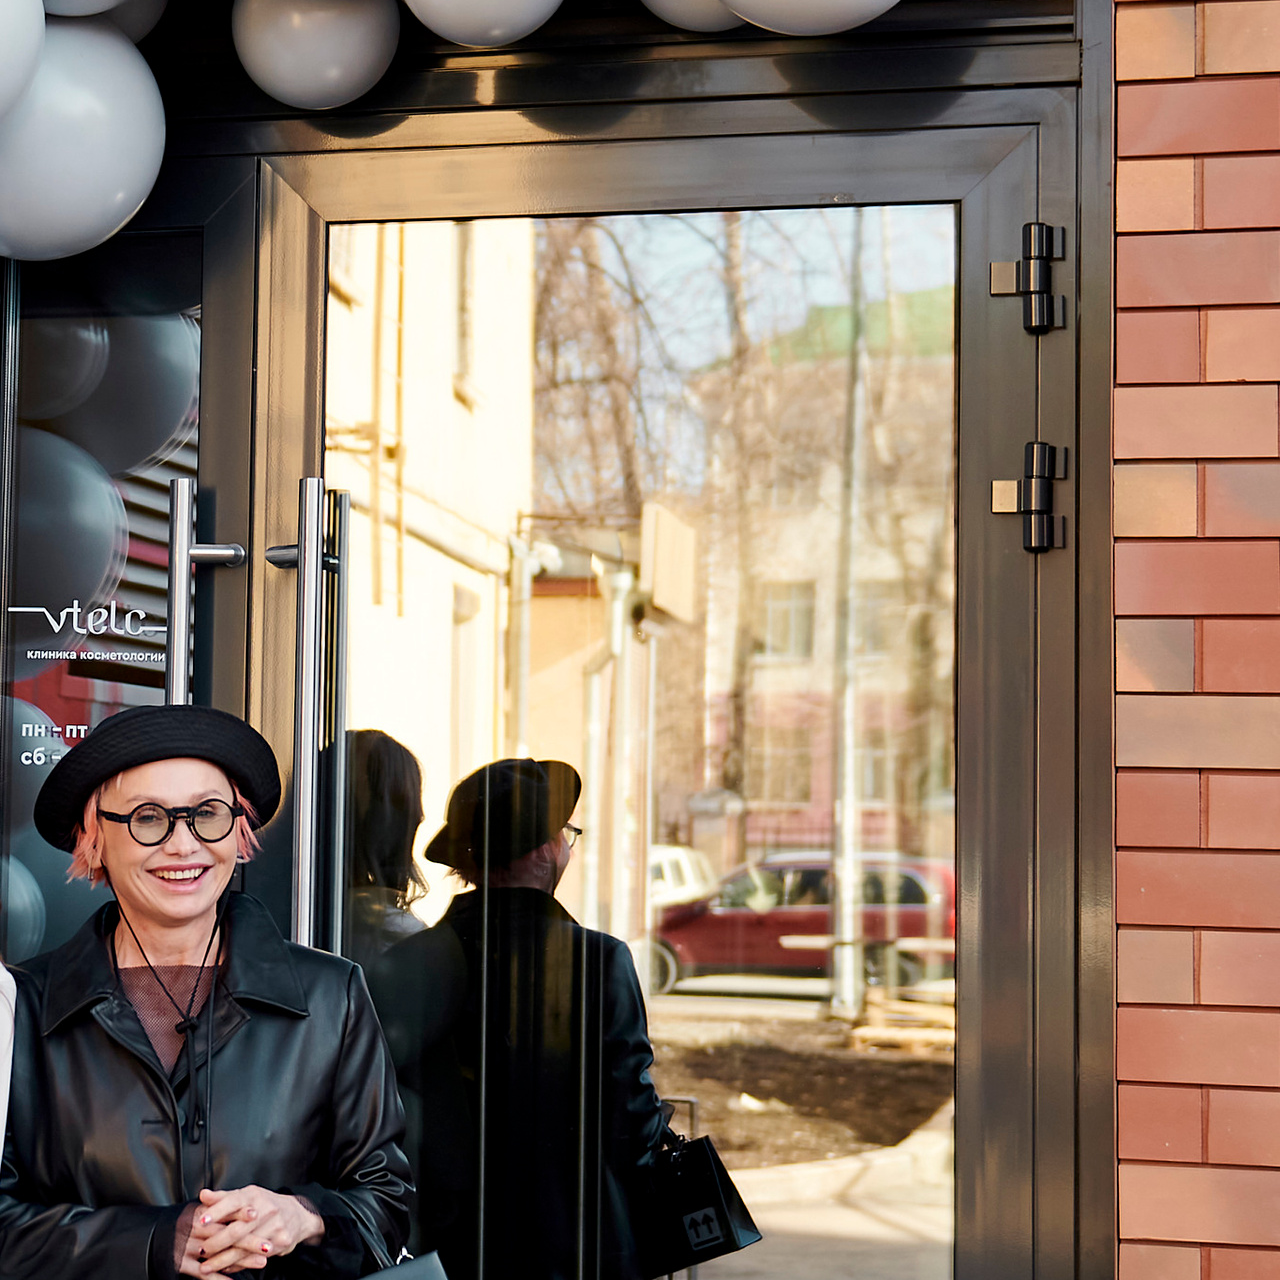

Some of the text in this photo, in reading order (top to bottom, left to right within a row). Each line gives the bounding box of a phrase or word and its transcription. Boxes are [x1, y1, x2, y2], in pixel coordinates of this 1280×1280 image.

[42, 599, 167, 635] vtelc
[26, 649, 166, 662] клиника косметологии
[21, 724, 46, 737] пн
[65, 725, 88, 739] пт
[20, 747, 46, 765] сб
